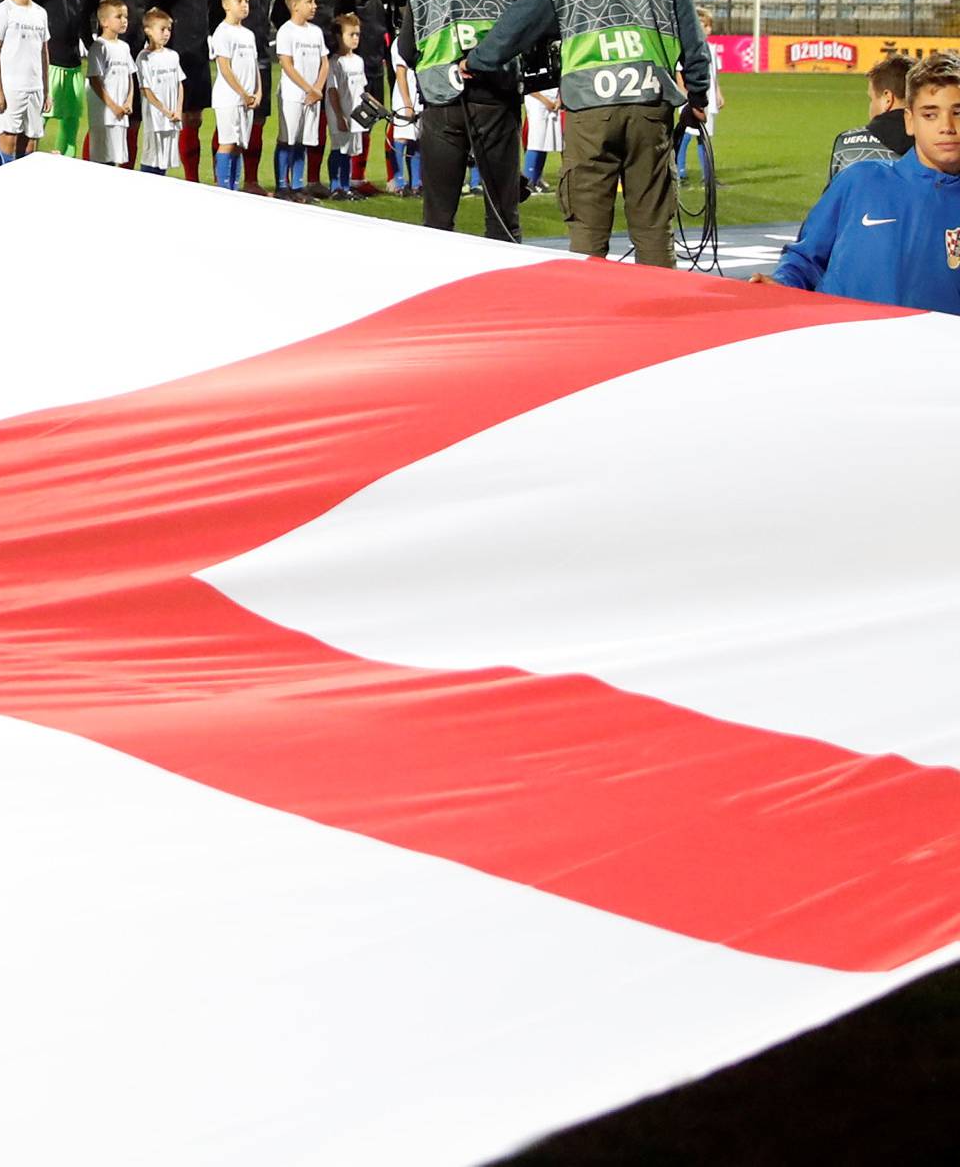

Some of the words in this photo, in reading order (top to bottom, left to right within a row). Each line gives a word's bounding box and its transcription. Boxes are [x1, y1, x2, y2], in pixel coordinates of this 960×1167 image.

[598, 30, 644, 61] HB
[593, 65, 661, 98] 024
[843, 134, 868, 144] UEFA
